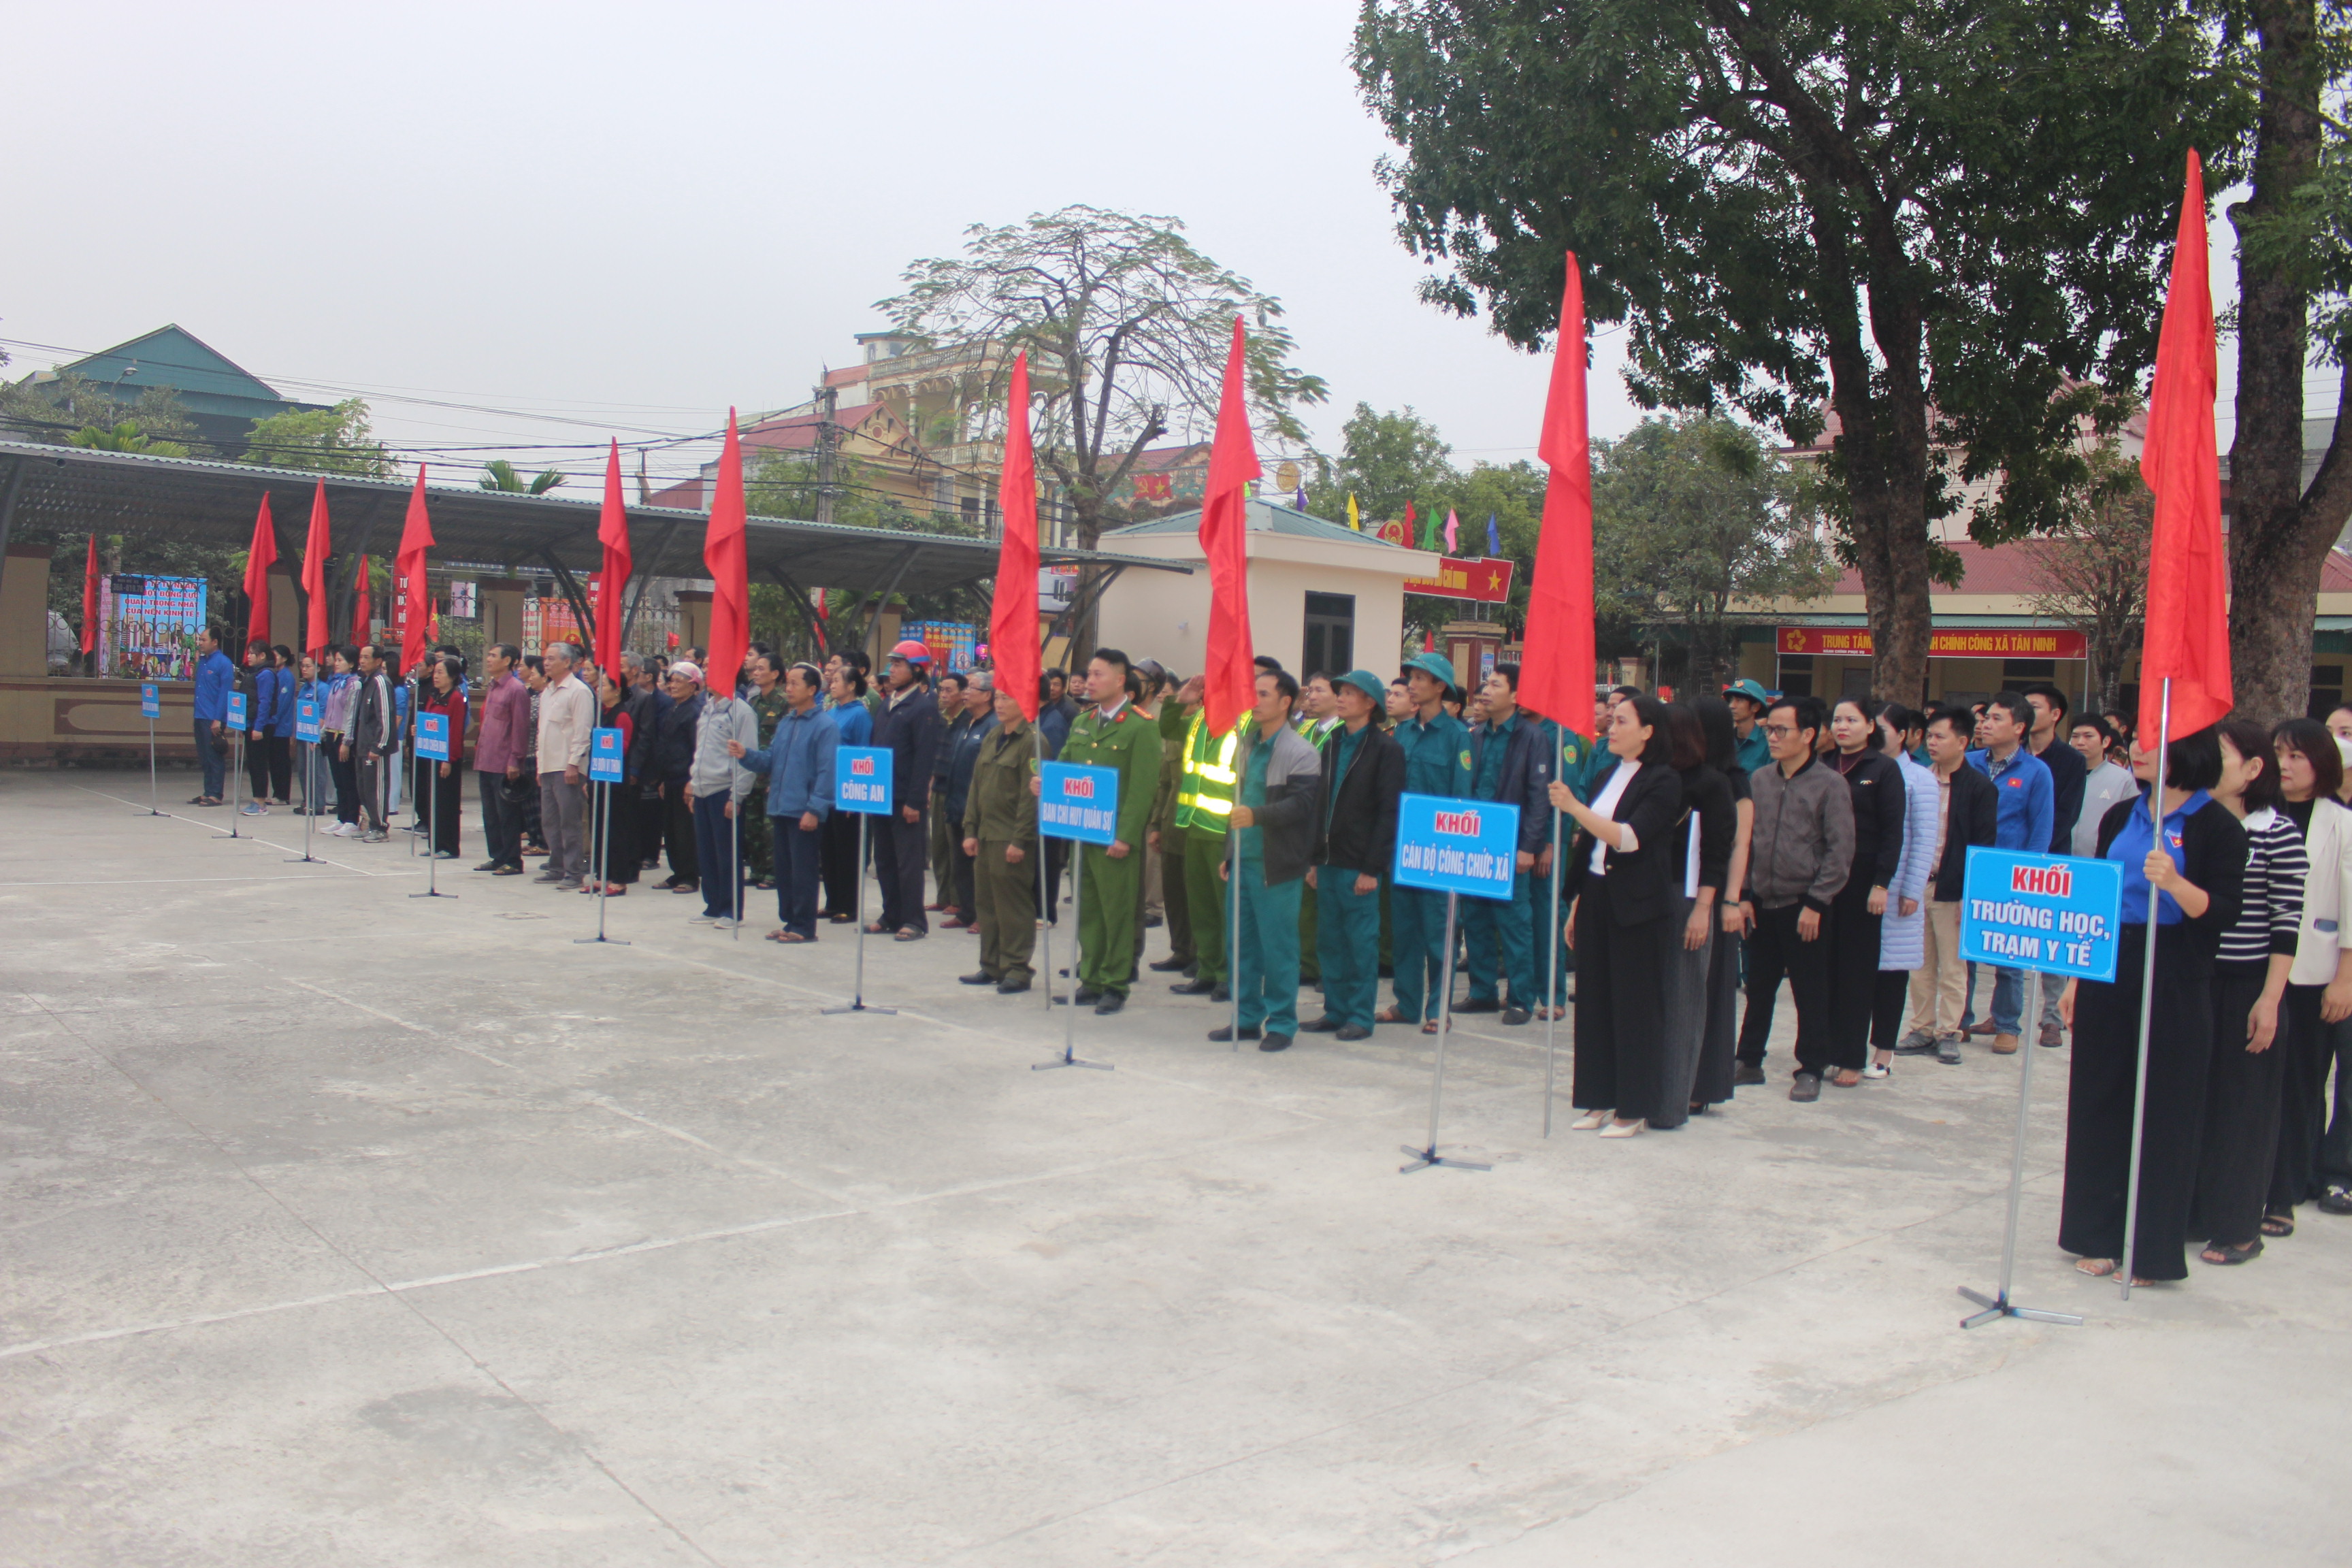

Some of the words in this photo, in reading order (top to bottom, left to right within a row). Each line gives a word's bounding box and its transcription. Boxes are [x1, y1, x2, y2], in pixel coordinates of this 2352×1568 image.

[1822, 635, 1850, 649] TRUNG
[1852, 632, 1872, 649] TÂM
[1940, 634, 1967, 651] CHÍNH
[1968, 634, 1993, 651] CÔNG
[1995, 634, 2009, 651] XÃ
[2011, 634, 2031, 651] TÂN
[2033, 637, 2057, 652] NINH
[601, 734, 614, 749] KHỐI
[851, 756, 874, 775] KHỐI
[842, 779, 868, 801] CÔNG
[870, 785, 885, 802] AN
[1064, 777, 1094, 799] KHỐI
[1043, 802, 1056, 822] BAN
[1058, 798, 1069, 824] CHỈ
[1069, 806, 1083, 826] HUY
[1083, 806, 1102, 830] QUÂN
[1102, 810, 1113, 836] SỰ
[1435, 810, 1481, 837] KHỐI
[1403, 840, 1422, 870] CÁN
[1423, 843, 1437, 877] BỘ
[1438, 845, 1465, 875] CÔNG
[1467, 847, 1493, 879] CHỨC
[1494, 852, 1509, 881] XÃ
[2010, 863, 2072, 898] KHỐI
[1971, 898, 2053, 930] TRƯỜNG
[2058, 911, 2111, 941] HỌC,
[1981, 930, 2040, 960] TRẠM
[2046, 939, 2061, 962] Y
[2065, 938, 2094, 968] TẾ
